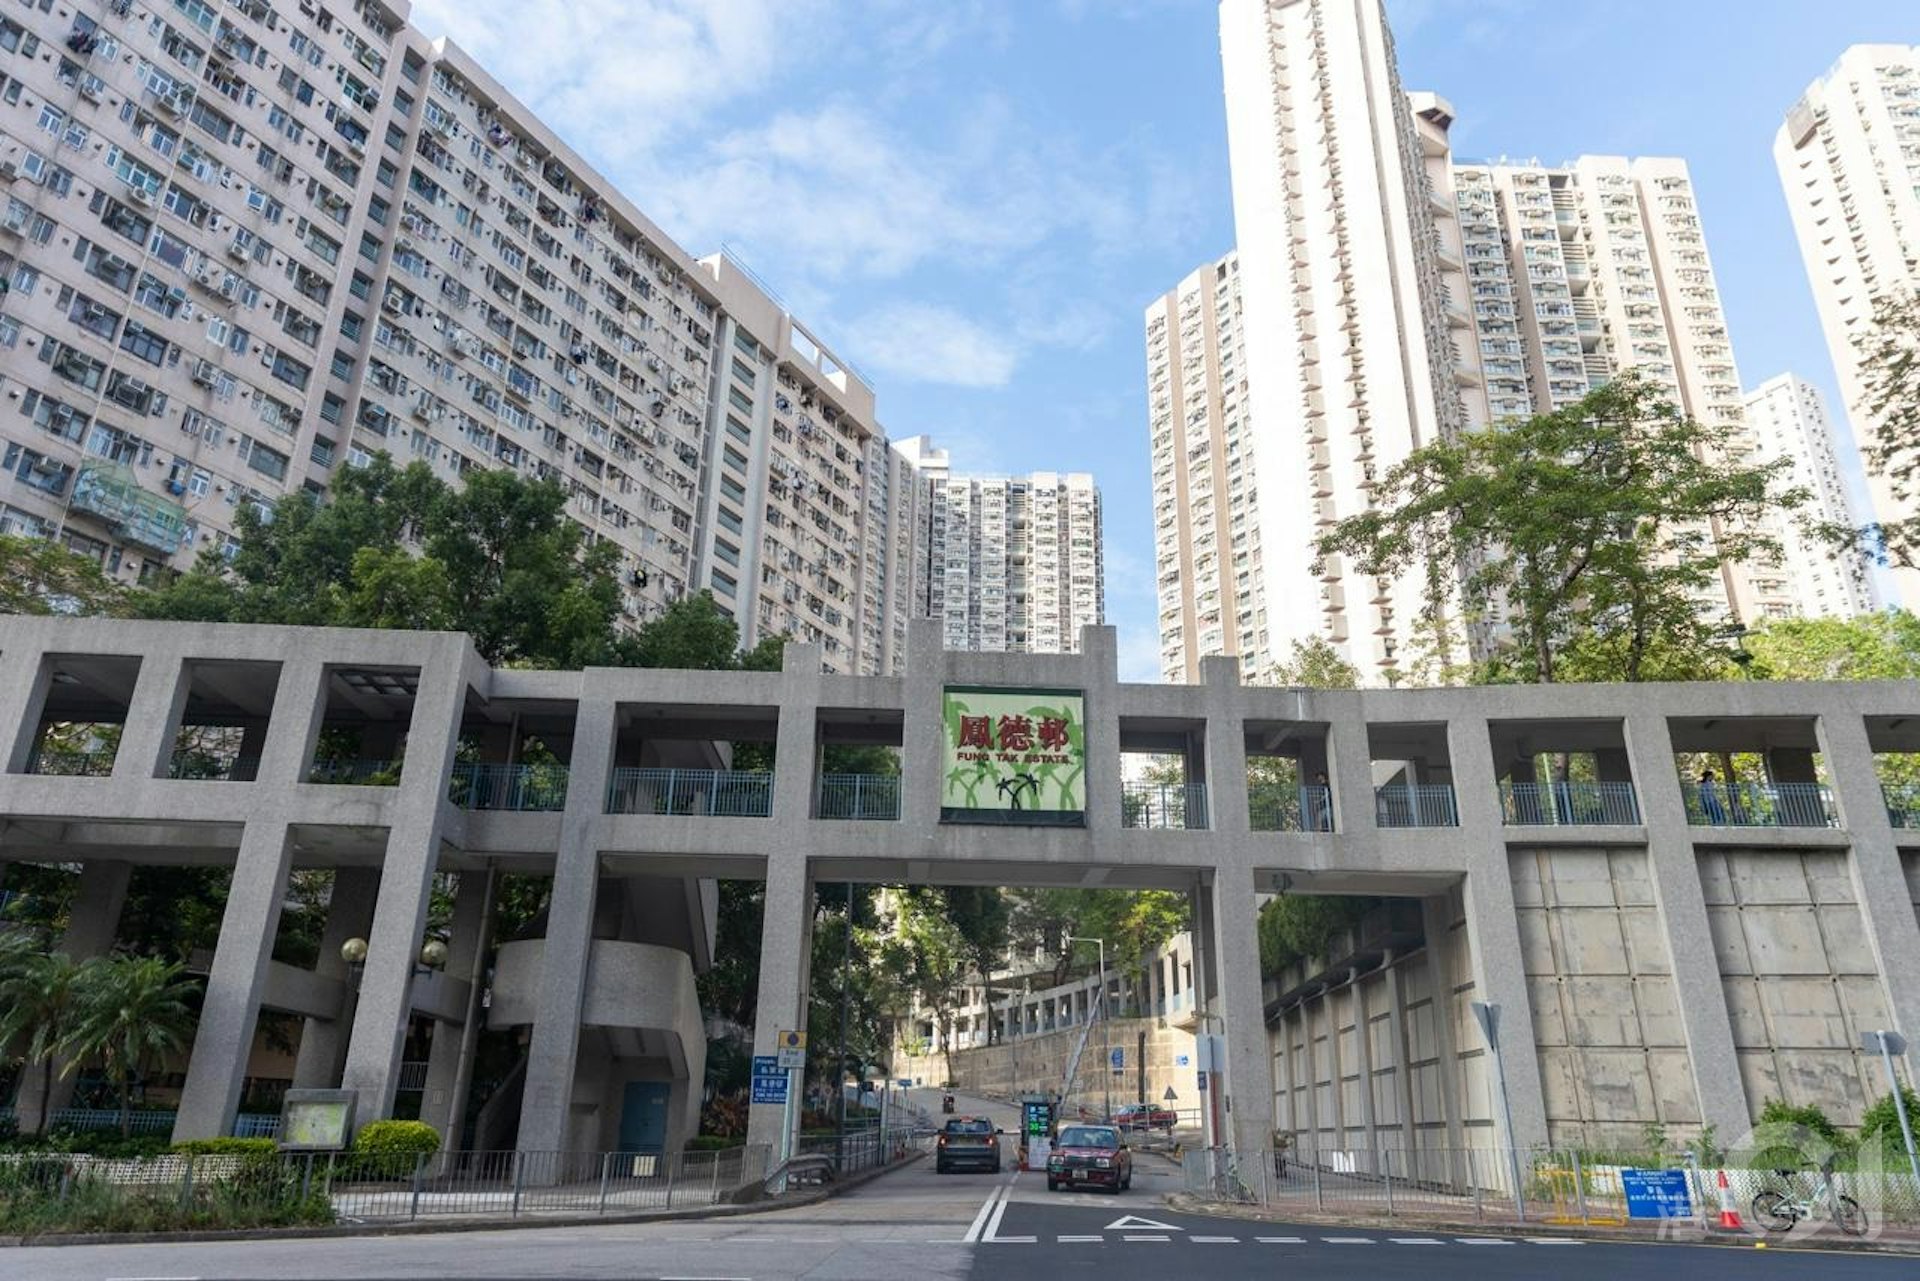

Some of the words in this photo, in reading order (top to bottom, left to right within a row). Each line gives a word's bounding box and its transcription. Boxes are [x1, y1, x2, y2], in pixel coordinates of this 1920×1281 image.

[957, 714, 1069, 751] 鳳德邨
[956, 752, 990, 762] FUNG
[996, 753, 1018, 763] TAK
[1024, 754, 1071, 765] ESTATE
